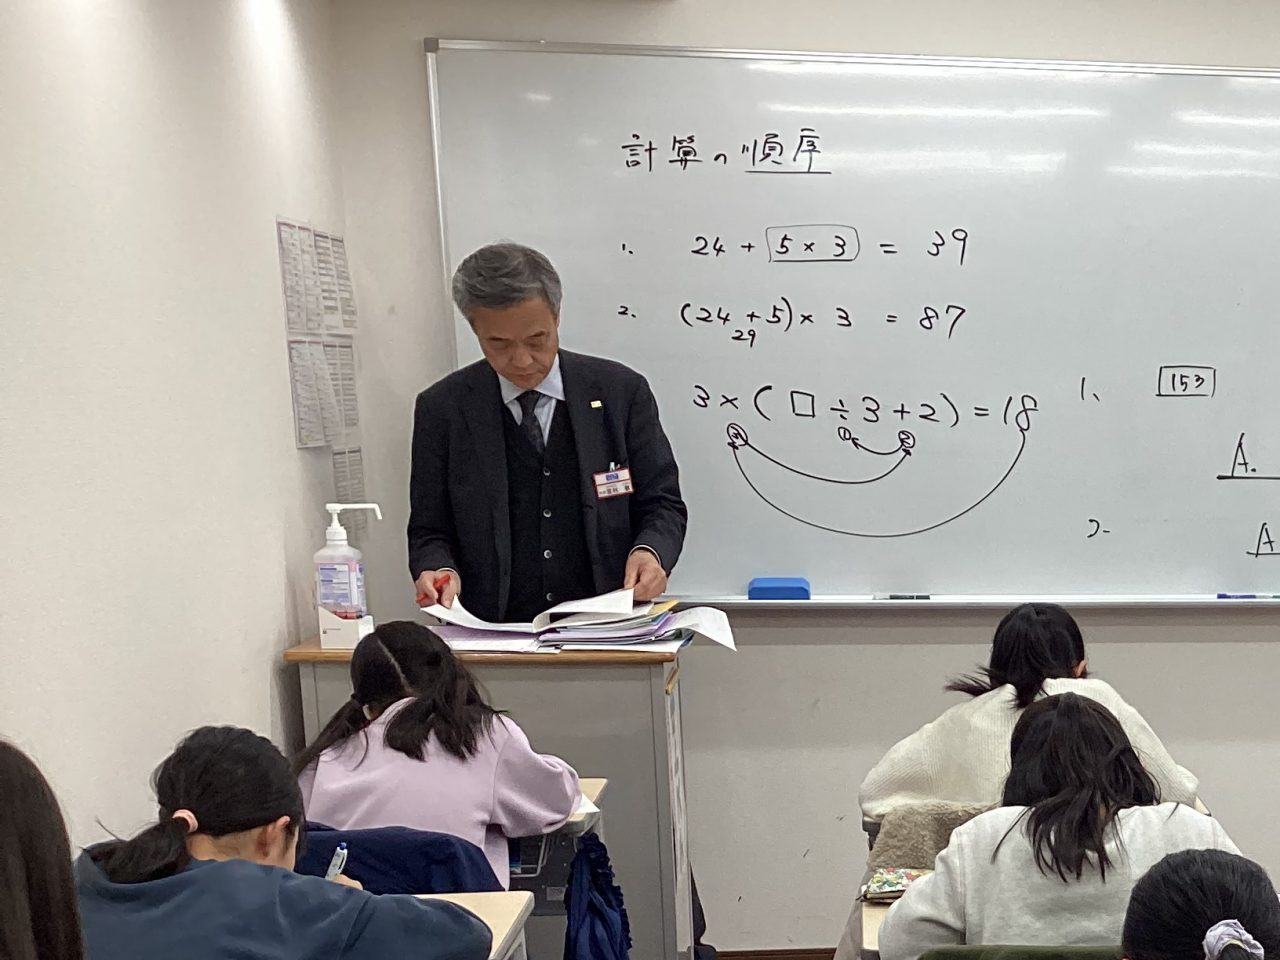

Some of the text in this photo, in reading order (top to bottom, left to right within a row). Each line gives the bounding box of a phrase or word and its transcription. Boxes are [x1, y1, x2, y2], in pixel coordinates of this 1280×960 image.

[621, 127, 832, 173] 計算の順序
[690, 235, 726, 258] 24
[740, 241, 756, 254] +
[774, 234, 793, 257] 5
[832, 235, 848, 258] 3
[879, 243, 898, 255] =
[926, 228, 969, 266] 39
[730, 329, 757, 348] 29
[835, 307, 852, 328] 3
[918, 305, 967, 339] 87
[1170, 373, 1205, 393] 153
